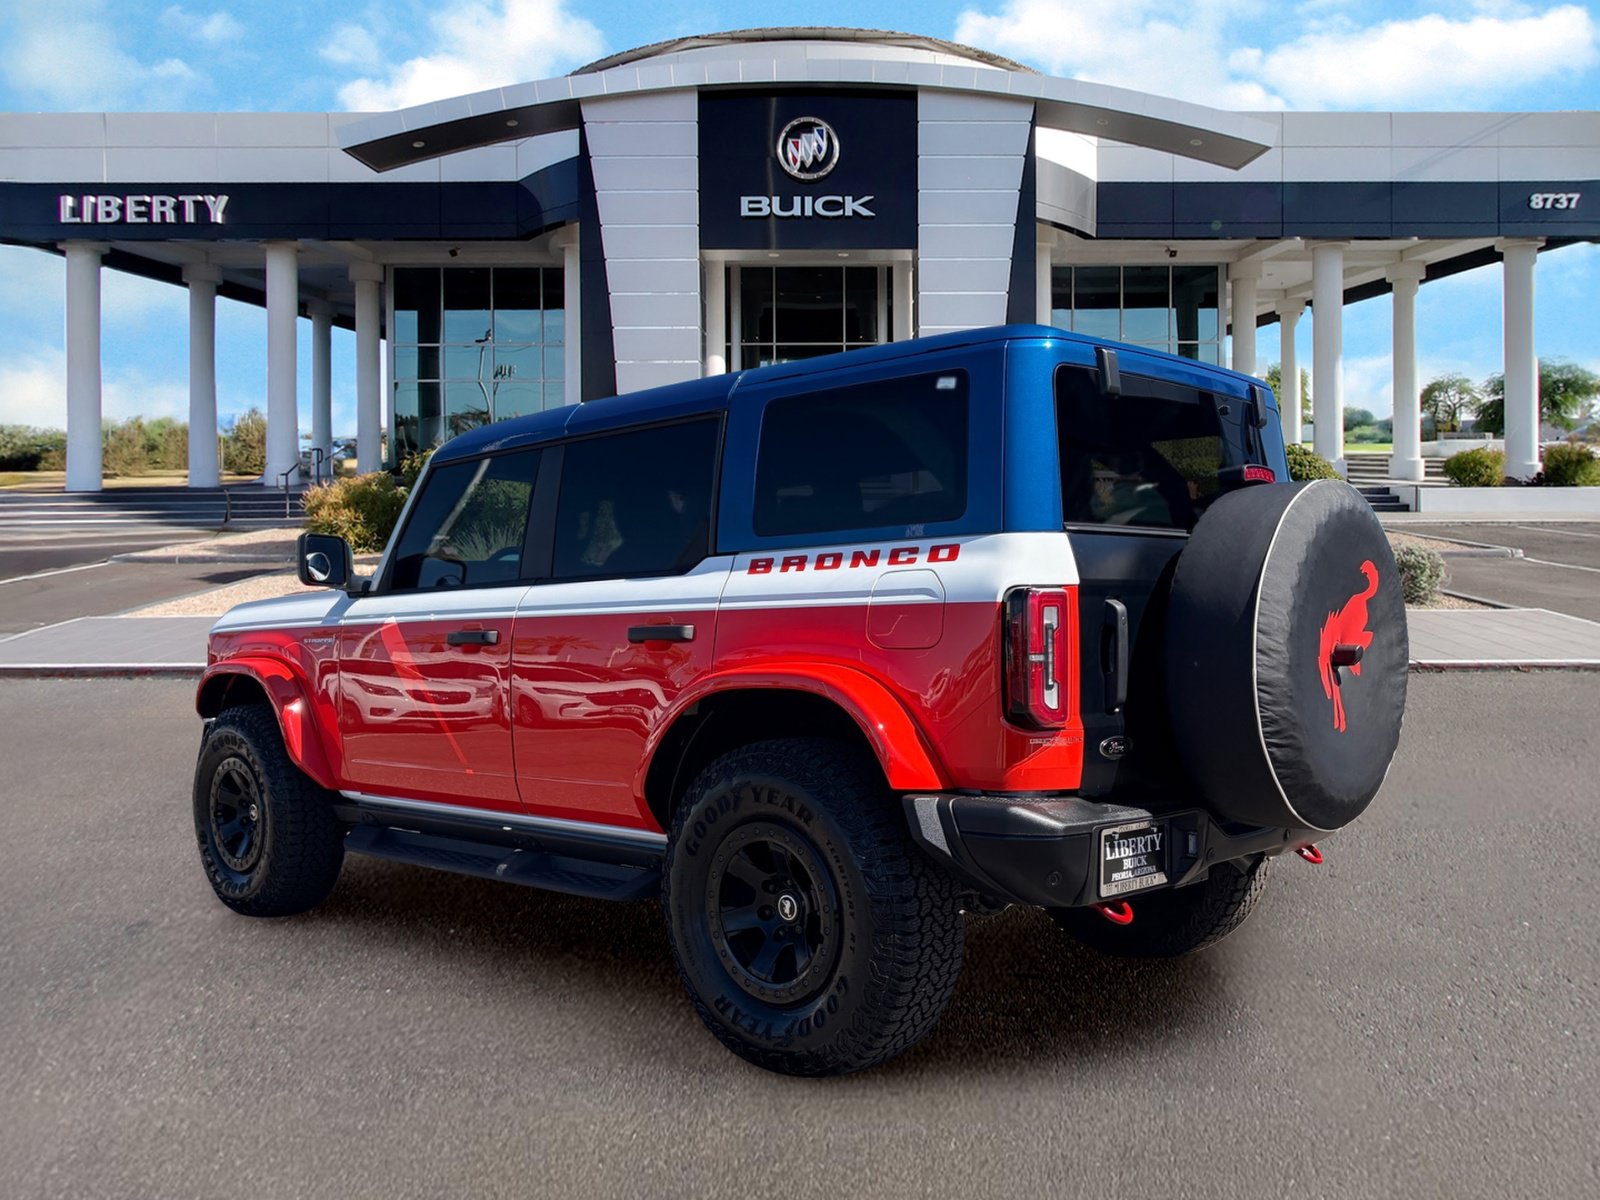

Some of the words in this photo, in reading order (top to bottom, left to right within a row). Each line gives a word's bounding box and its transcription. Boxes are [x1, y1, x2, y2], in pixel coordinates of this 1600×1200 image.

[59, 194, 229, 224] LIBERTY
[740, 195, 876, 217] BUICK
[1529, 192, 1581, 210] 8737
[747, 543, 961, 575] BRONCO
[1104, 833, 1163, 861] LIBERTY
[1122, 855, 1148, 870] BUICK
